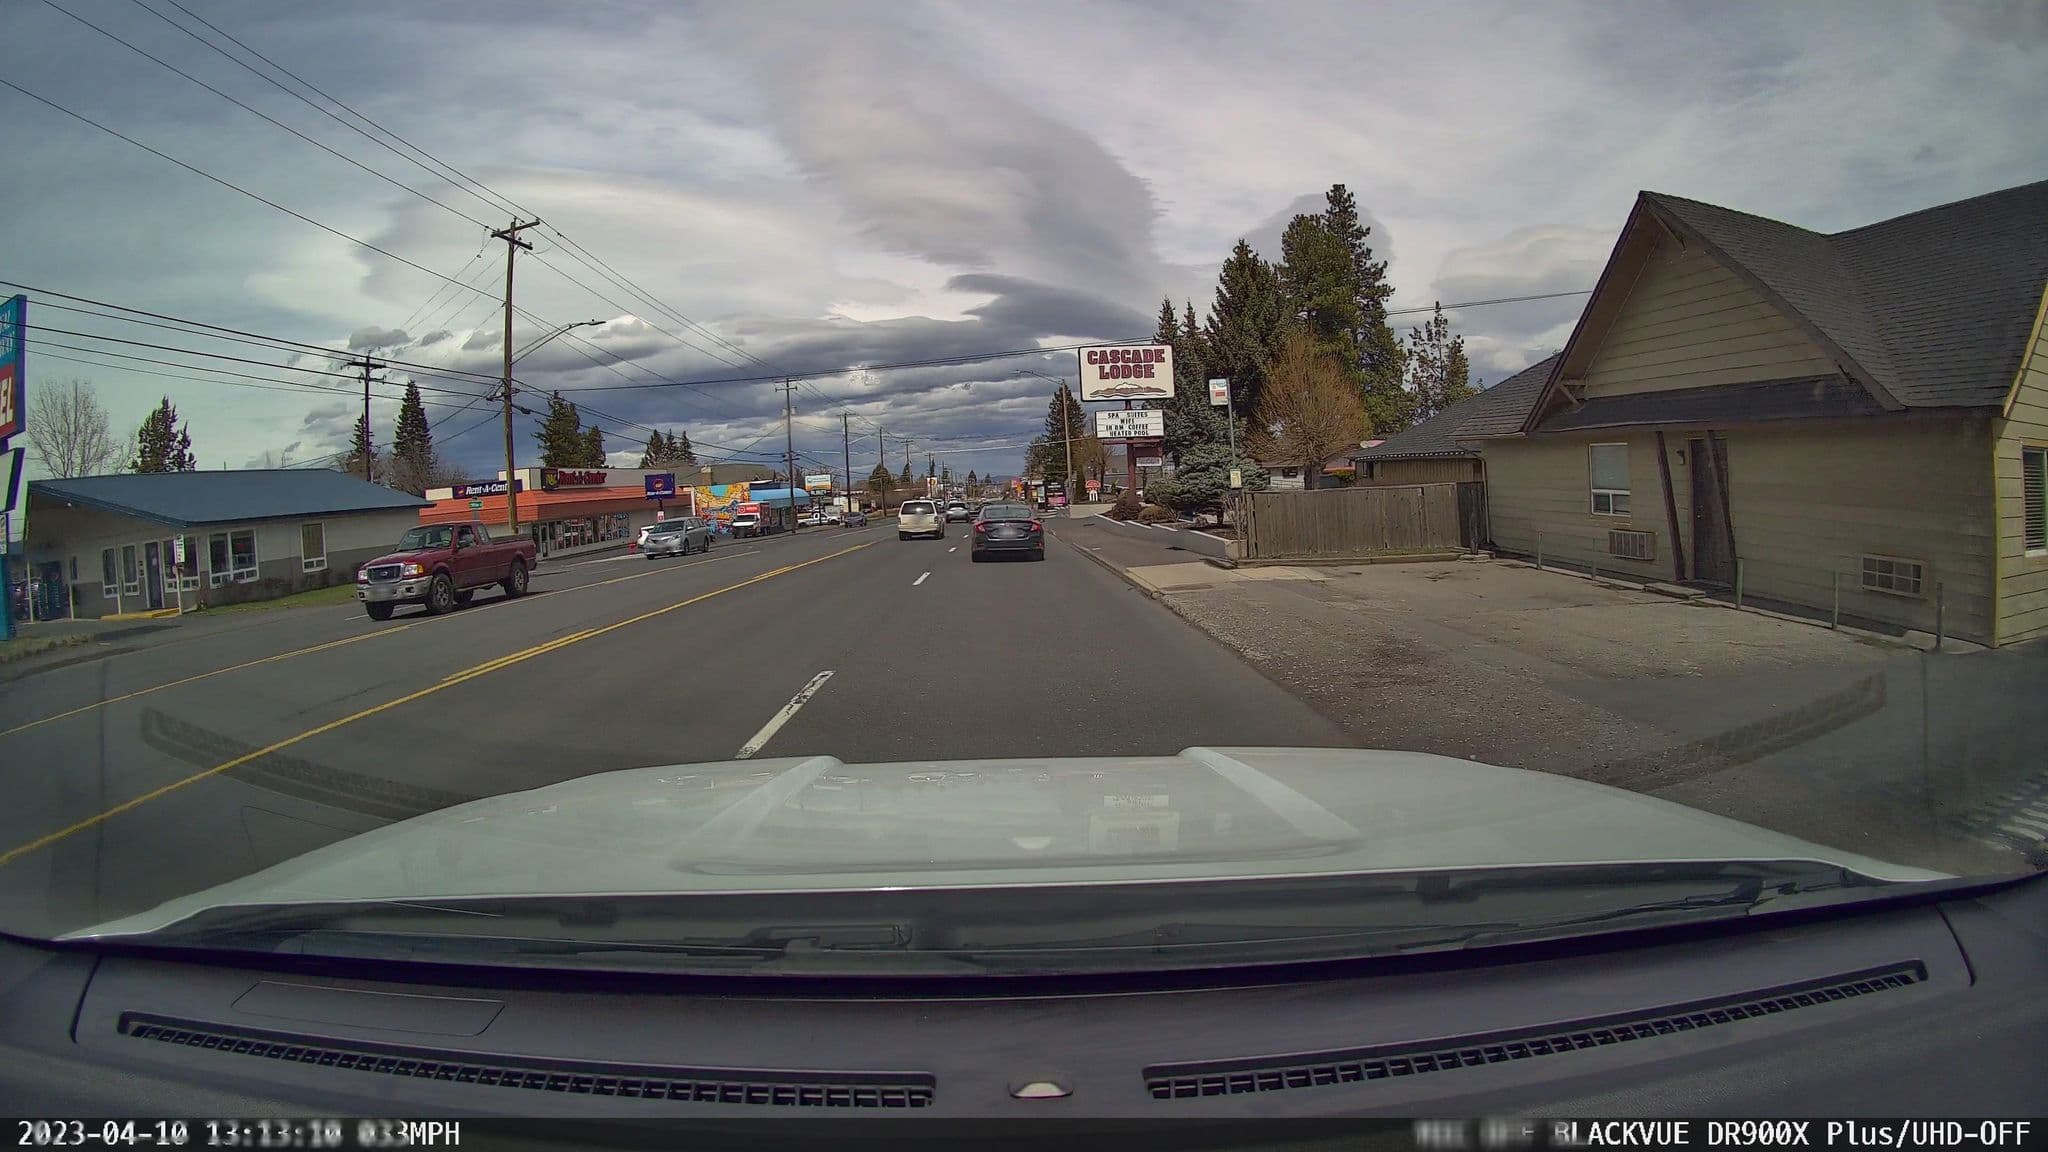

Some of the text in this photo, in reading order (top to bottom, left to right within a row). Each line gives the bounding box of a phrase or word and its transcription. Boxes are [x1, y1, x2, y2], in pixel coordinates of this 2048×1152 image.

[1087, 349, 1165, 365] CASCADE
[1099, 364, 1155, 379] LODGE
[0, 376, 13, 426] EL
[466, 483, 508, 495] Rent-A-Cent
